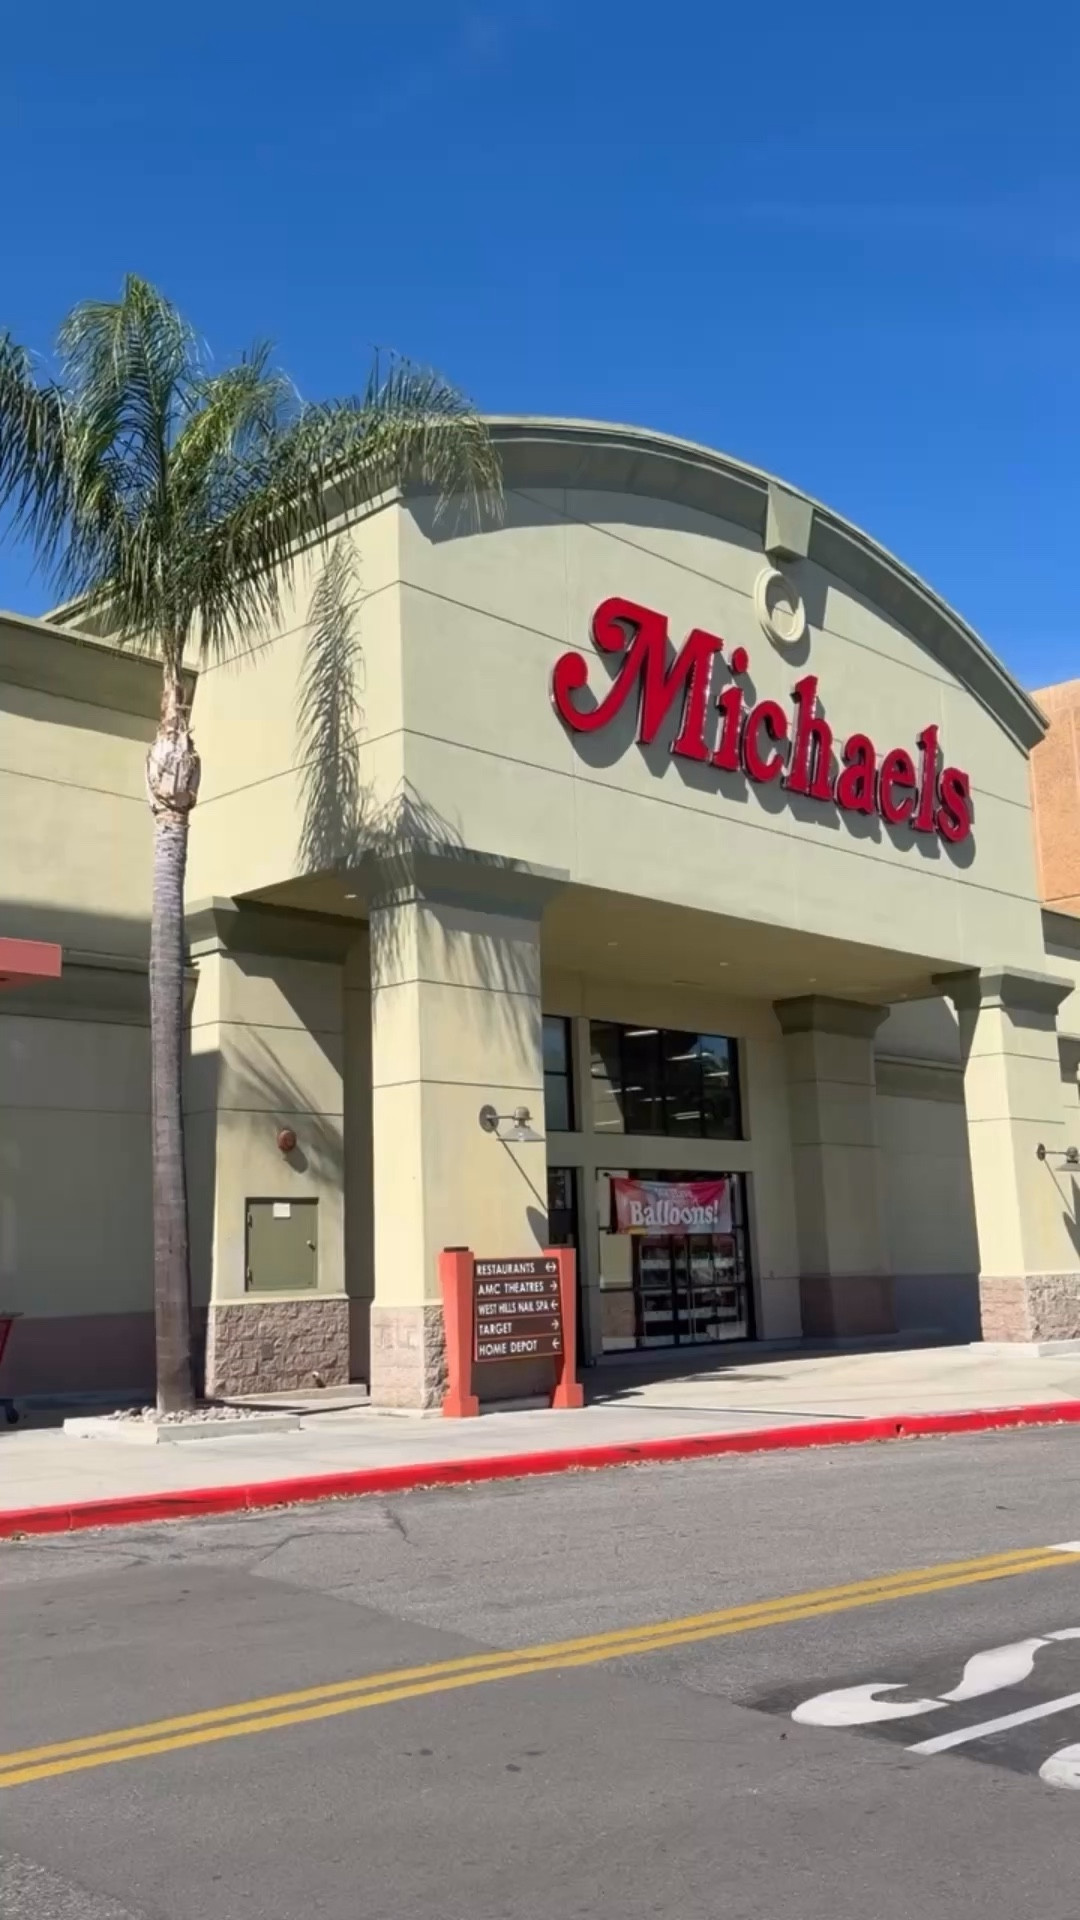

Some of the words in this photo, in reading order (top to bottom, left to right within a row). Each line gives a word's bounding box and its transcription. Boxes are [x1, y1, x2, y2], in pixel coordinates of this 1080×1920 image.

[551, 596, 972, 843] Michaels
[629, 1200, 719, 1225] Balloons!
[476, 1262, 535, 1276] RESTAURANTS
[478, 1283, 501, 1295] AMC
[504, 1281, 544, 1294] THEATRES
[478, 1303, 497, 1315] WEST
[499, 1302, 516, 1314] HILLS
[518, 1301, 534, 1312] NAIL
[535, 1300, 549, 1311] SPA
[479, 1322, 512, 1335] TARGET
[479, 1343, 507, 1356] HOME
[510, 1340, 538, 1353] DEPOT
